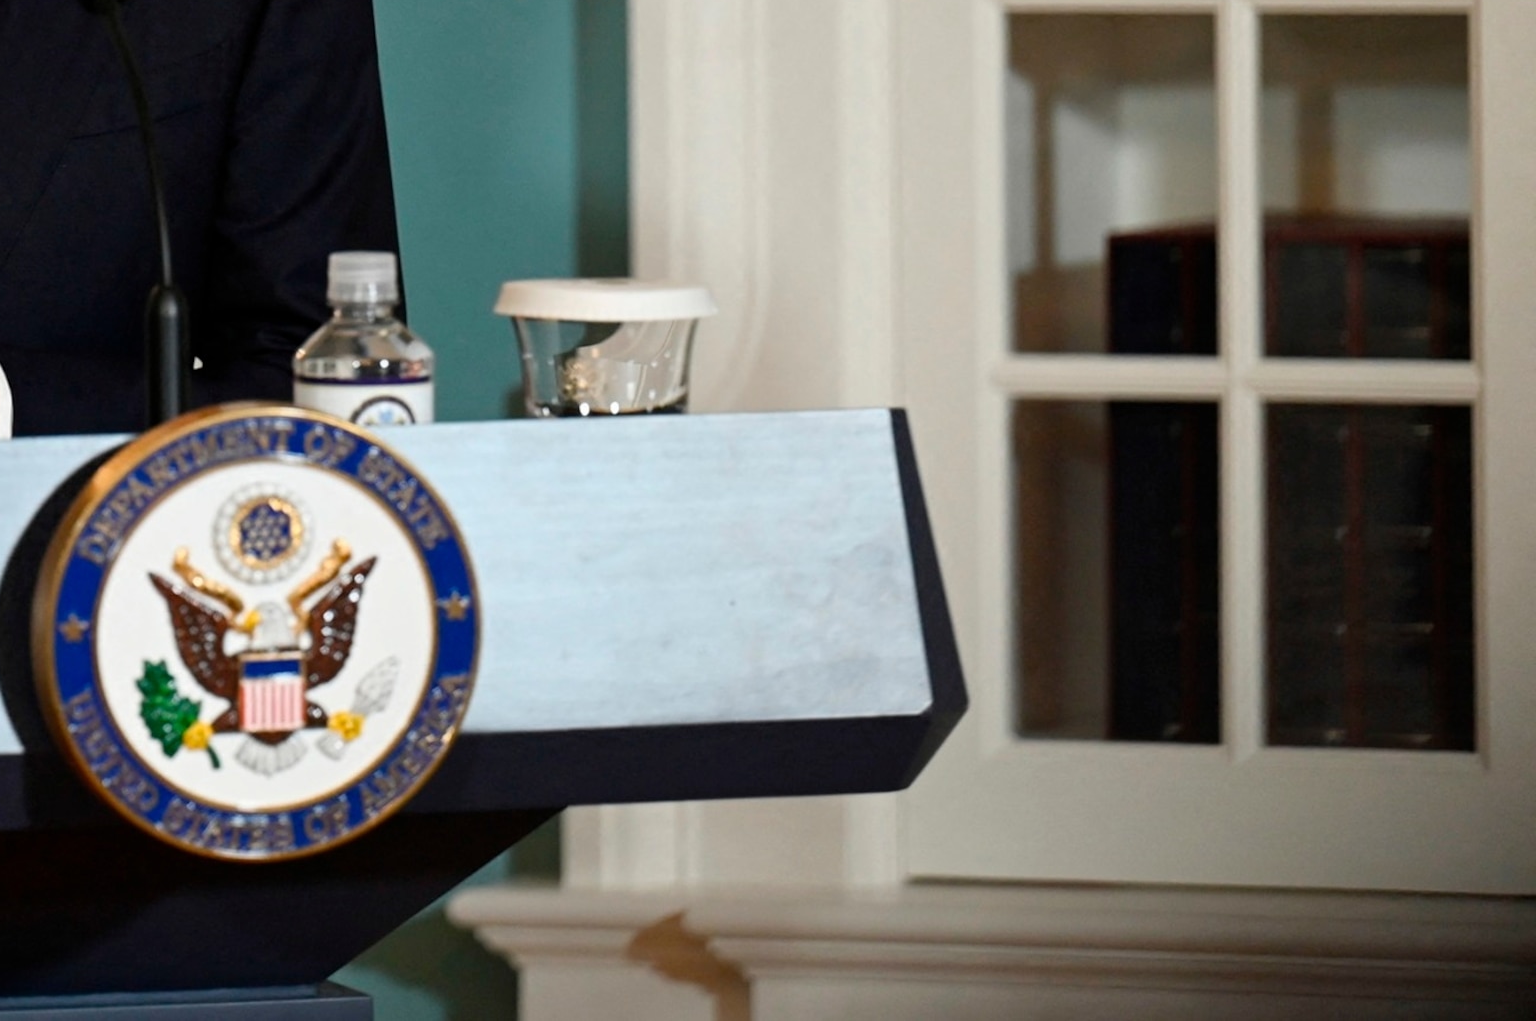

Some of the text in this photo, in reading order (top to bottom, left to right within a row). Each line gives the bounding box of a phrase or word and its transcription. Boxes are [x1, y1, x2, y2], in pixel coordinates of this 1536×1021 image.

[76, 420, 448, 565] DEPARTMENT OF STATE
[66, 675, 469, 853] UNITED STATES OF AMERICA
